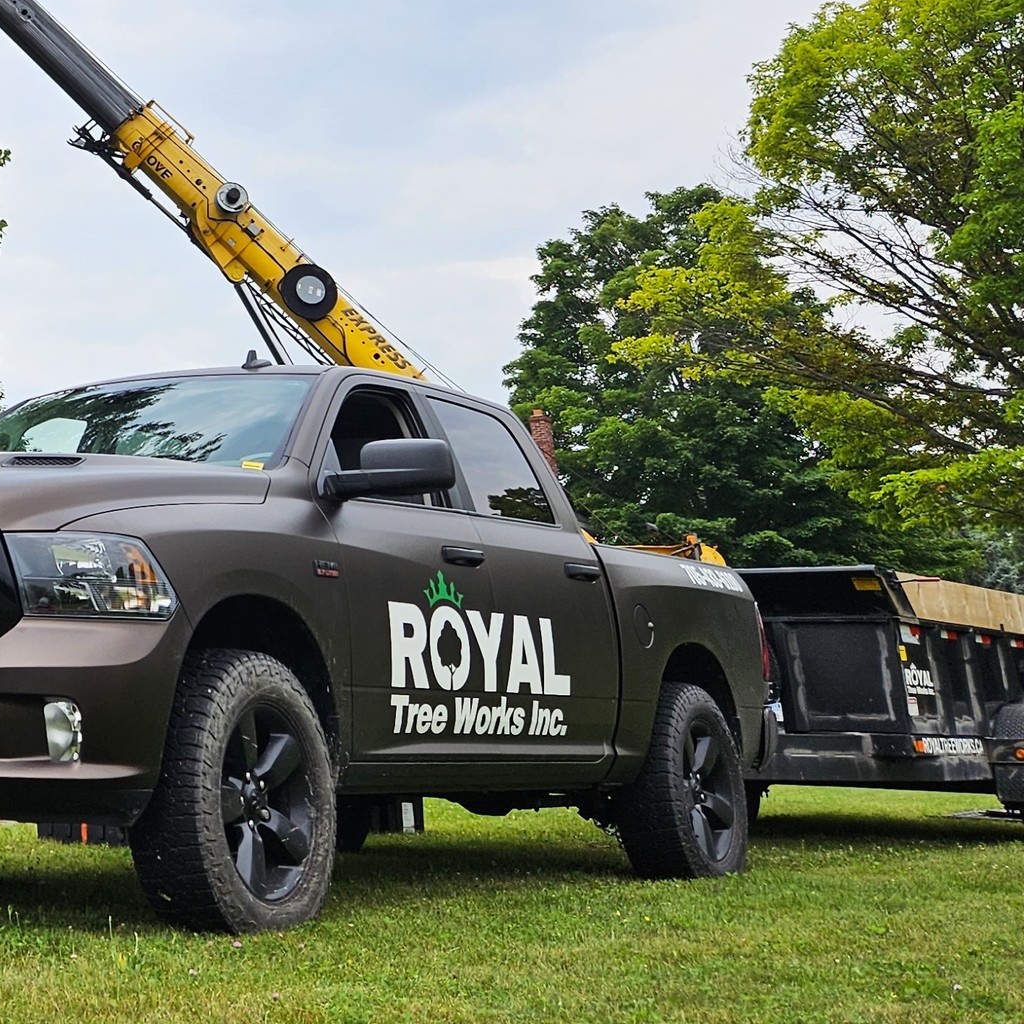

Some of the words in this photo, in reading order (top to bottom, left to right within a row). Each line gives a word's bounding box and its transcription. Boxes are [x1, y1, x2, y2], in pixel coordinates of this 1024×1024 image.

[132, 137, 173, 179] GOVE
[341, 308, 412, 370] EXPRESS
[388, 601, 571, 696] ROYAL
[904, 668, 934, 687] ROYAL
[390, 694, 449, 734] Tree
[453, 696, 526, 736] Works
[528, 700, 568, 737] Inc.
